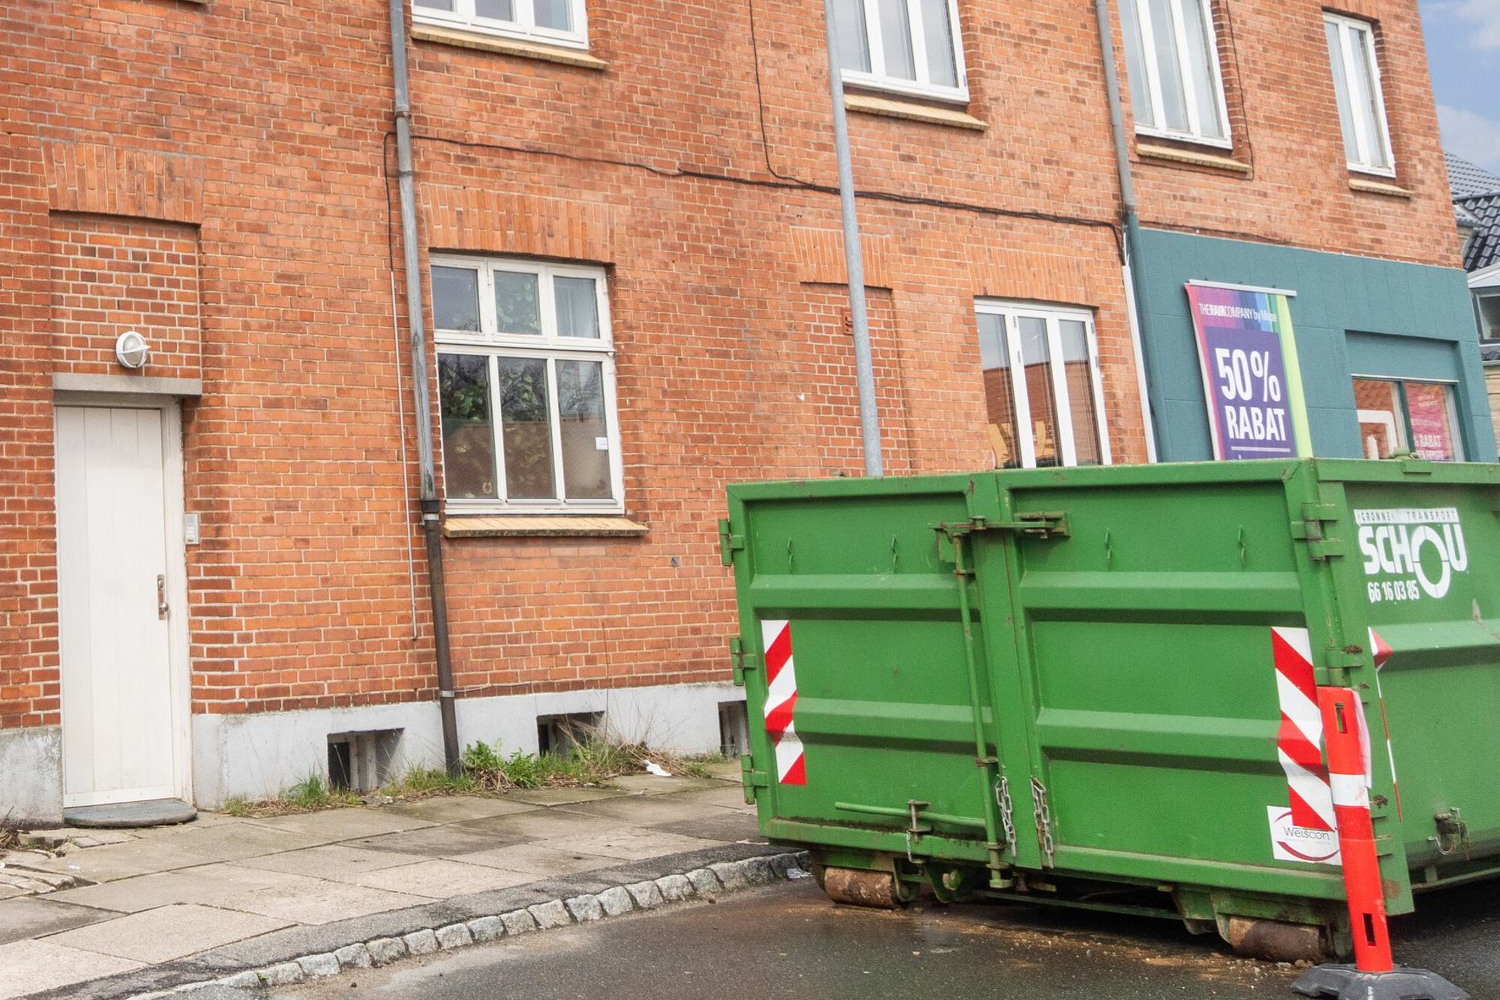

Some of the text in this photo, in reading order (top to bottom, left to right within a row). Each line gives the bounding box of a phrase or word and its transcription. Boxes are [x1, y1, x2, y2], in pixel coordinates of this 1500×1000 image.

[1215, 348, 1281, 402] 50%
[1224, 405, 1286, 441] RABAT
[1406, 510, 1456, 521] TRANSPORT
[1358, 523, 1467, 599] SCHOU
[1367, 580, 1420, 603] 66 16 03 85
